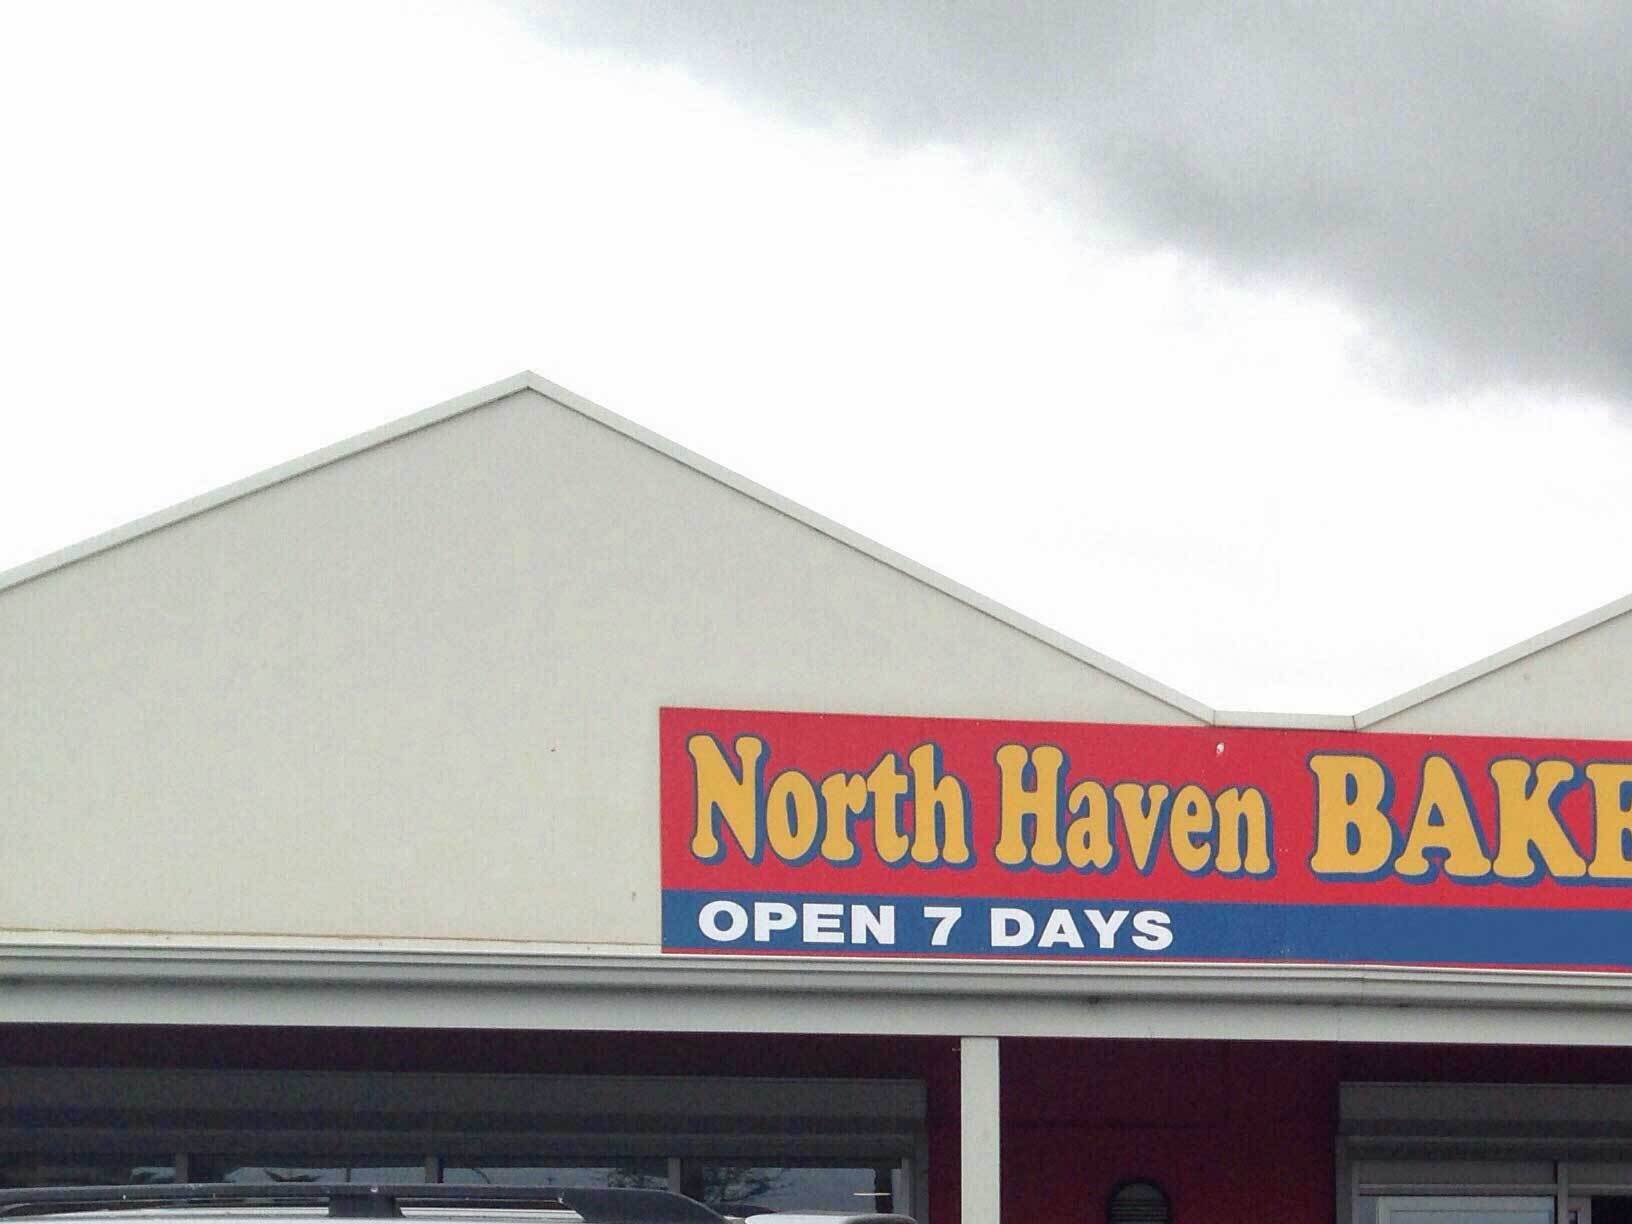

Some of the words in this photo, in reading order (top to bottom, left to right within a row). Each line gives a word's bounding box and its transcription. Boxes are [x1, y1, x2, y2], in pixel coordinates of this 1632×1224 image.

[687, 734, 974, 867] North
[994, 744, 1275, 876] Haven
[699, 901, 896, 946] OPEN
[923, 906, 963, 947] 7
[990, 907, 1174, 951] DAYS
